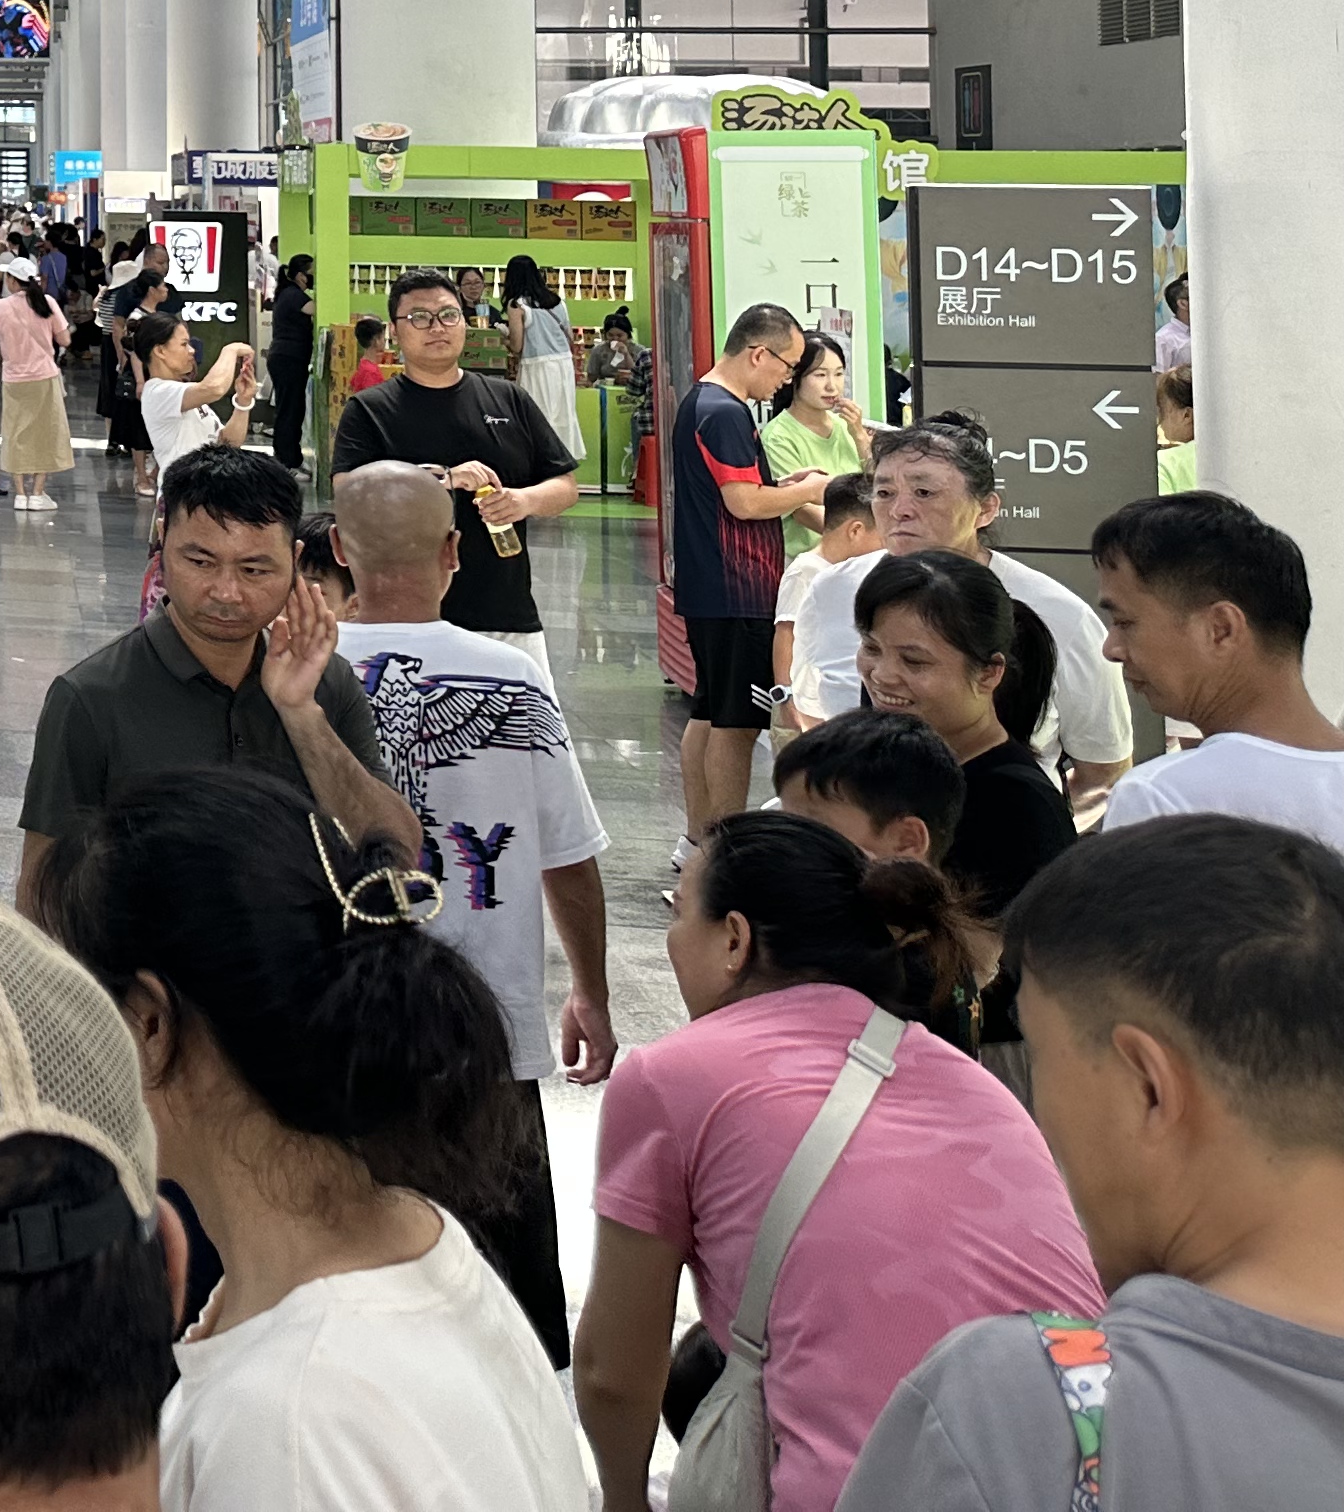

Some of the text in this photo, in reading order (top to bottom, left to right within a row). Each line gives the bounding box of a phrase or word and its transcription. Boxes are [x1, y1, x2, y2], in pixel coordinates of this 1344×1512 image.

[721, 93, 930, 192] 汤达人 馆
[935, 246, 1138, 285] D14~D15
[181, 301, 237, 322] KFC
[937, 286, 1002, 314] 展厅
[937, 313, 1036, 328] Exhibition Hall
[1013, 506, 1040, 519] Hall
